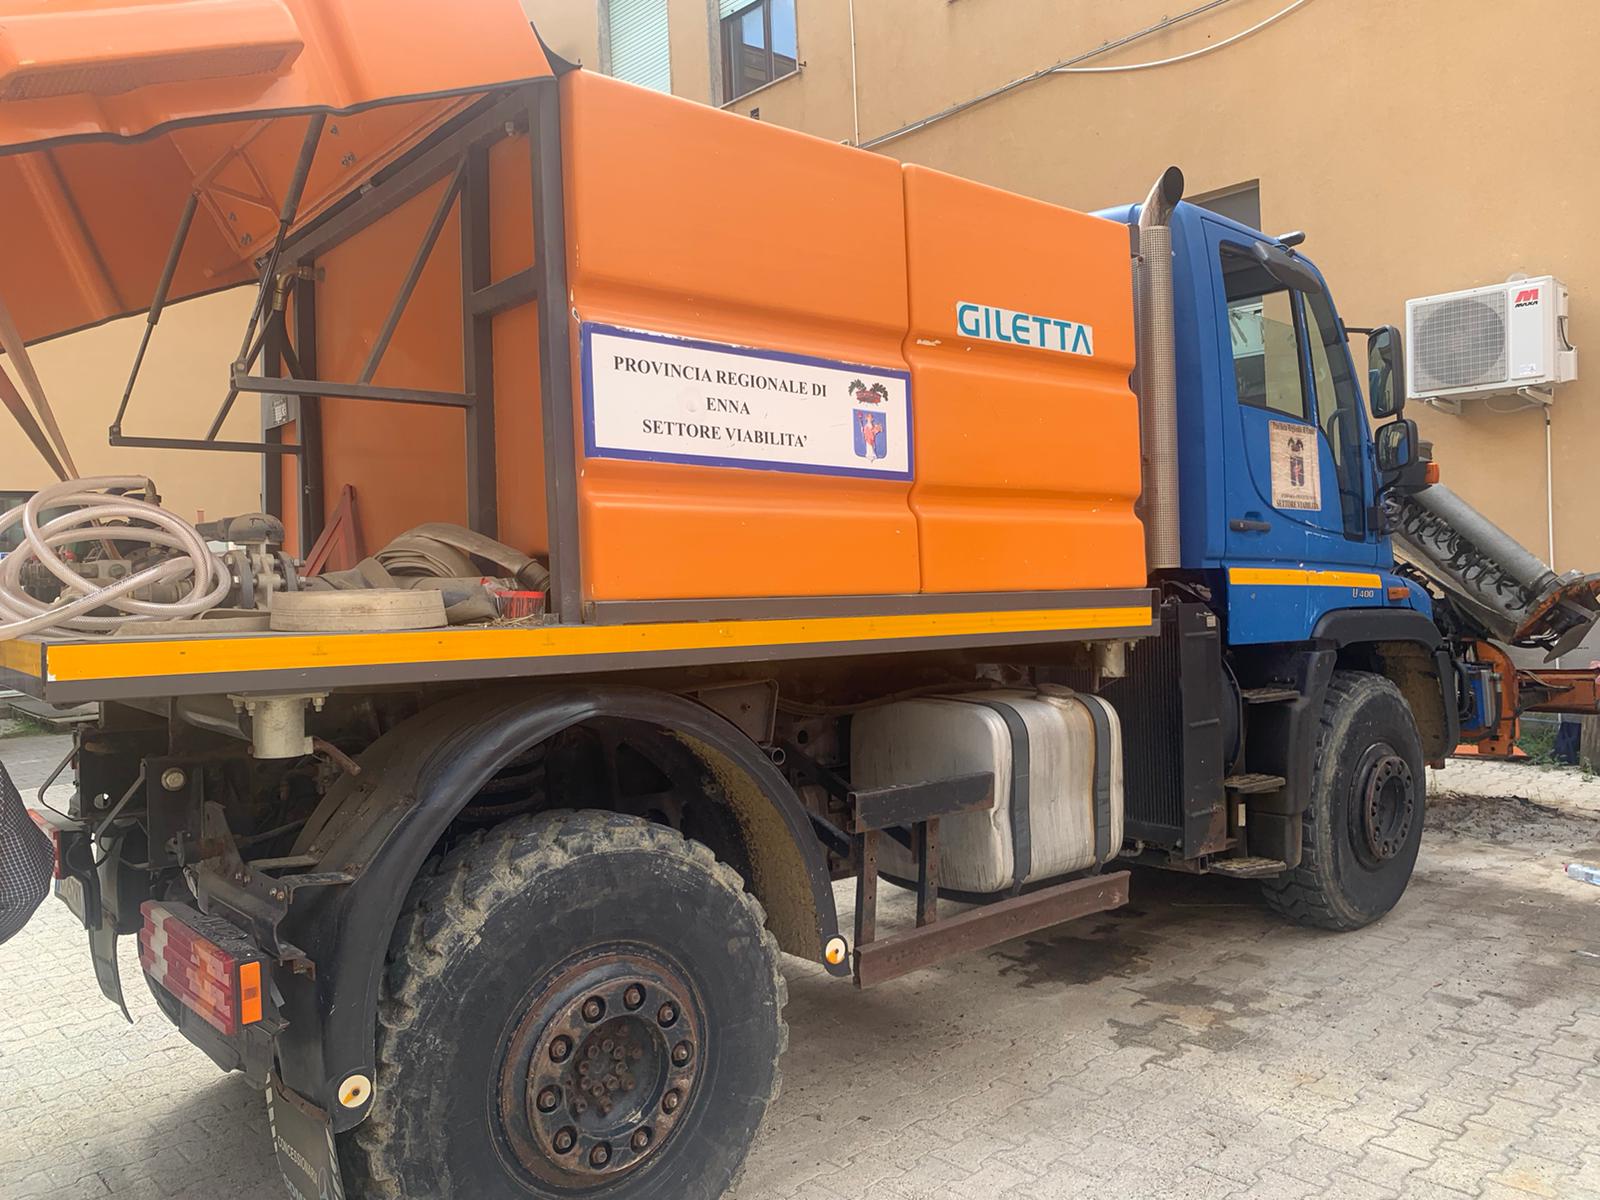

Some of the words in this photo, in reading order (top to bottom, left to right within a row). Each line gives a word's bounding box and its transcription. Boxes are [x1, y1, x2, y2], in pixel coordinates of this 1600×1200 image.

[958, 304, 1092, 355] GILETTA
[613, 355, 712, 383] PROVINCIA
[716, 369, 808, 396] REGIONALE
[811, 383, 827, 397] DI
[706, 397, 751, 415] ENNA
[642, 418, 721, 441] SETTORE
[1359, 590, 1374, 598] 400
